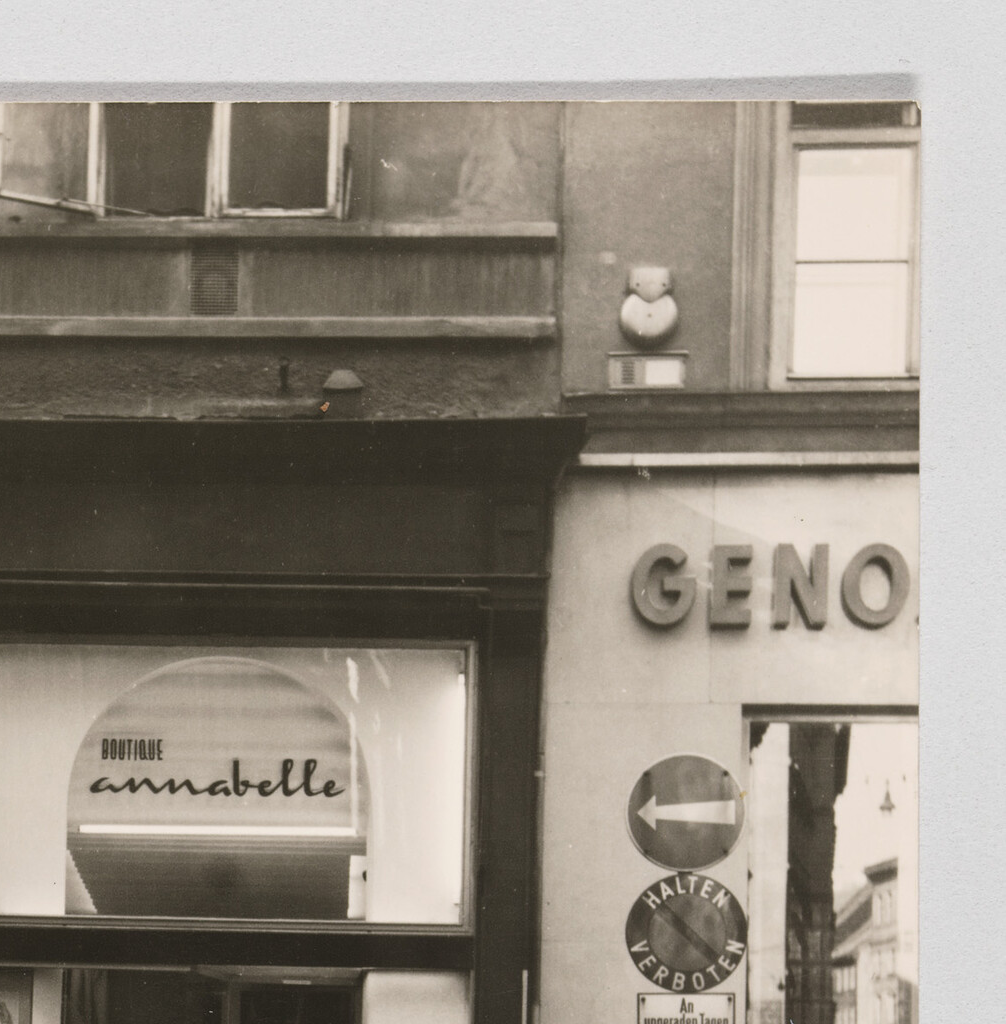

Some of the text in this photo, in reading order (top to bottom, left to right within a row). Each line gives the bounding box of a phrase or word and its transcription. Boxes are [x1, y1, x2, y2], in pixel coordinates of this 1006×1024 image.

[630, 542, 919, 630] GENO
[101, 738, 164, 761] BOUTIQUE
[89, 758, 346, 797] annabelle
[644, 875, 731, 909] HALTEN
[631, 938, 745, 990] VERBOTEN
[679, 997, 694, 1014] An
